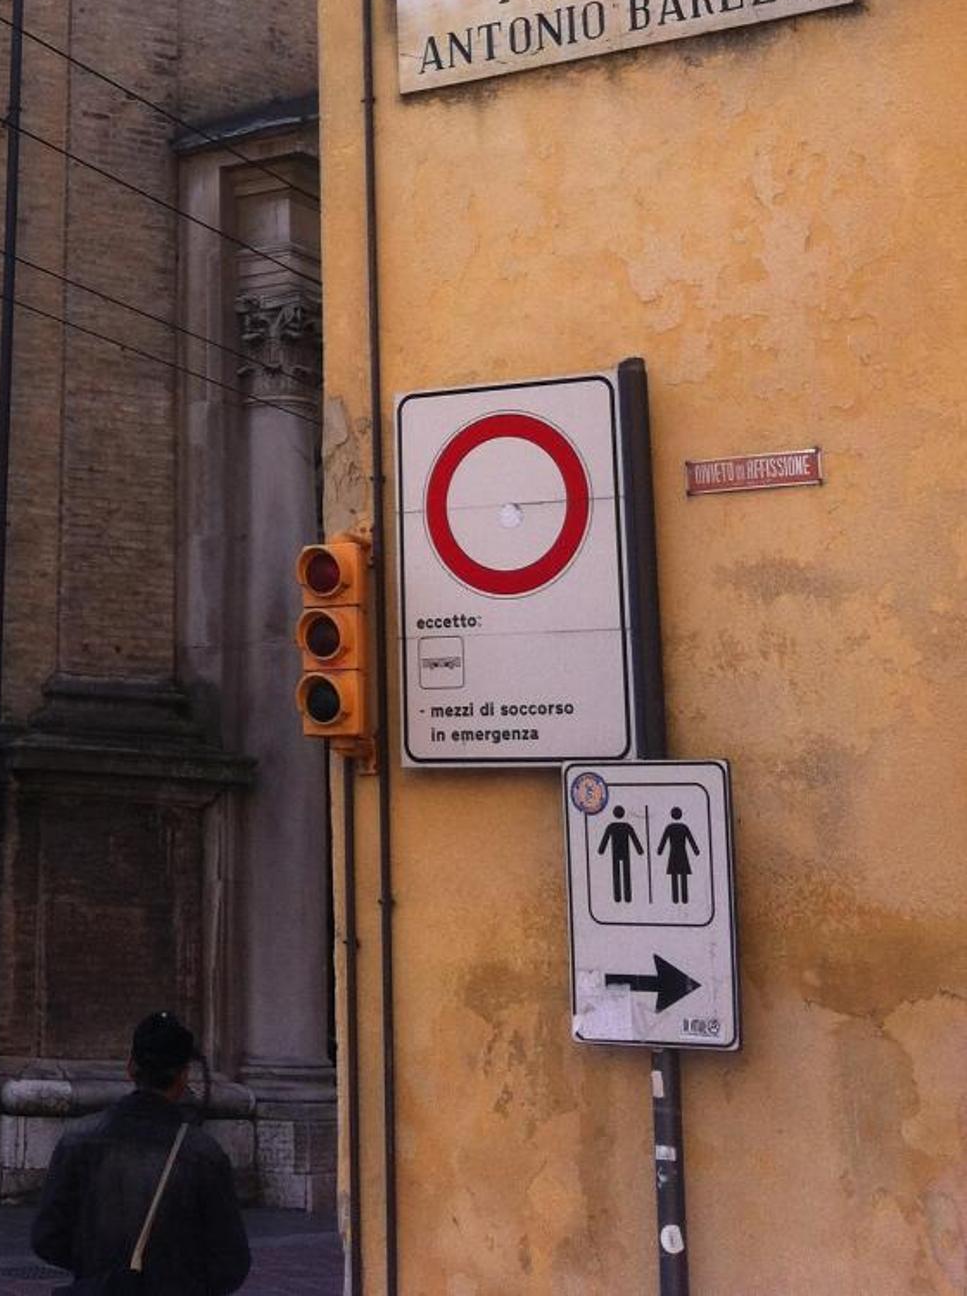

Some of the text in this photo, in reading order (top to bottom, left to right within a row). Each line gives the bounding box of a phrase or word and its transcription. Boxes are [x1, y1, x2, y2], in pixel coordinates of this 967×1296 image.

[419, 1, 606, 75] ANTONIO
[746, 455, 811, 480] AFFISSIONE
[416, 614, 482, 630] eccetto:
[430, 702, 474, 718] mezzi
[479, 702, 495, 717] di
[500, 703, 575, 717] soccorso
[430, 727, 540, 744] in emergenza
